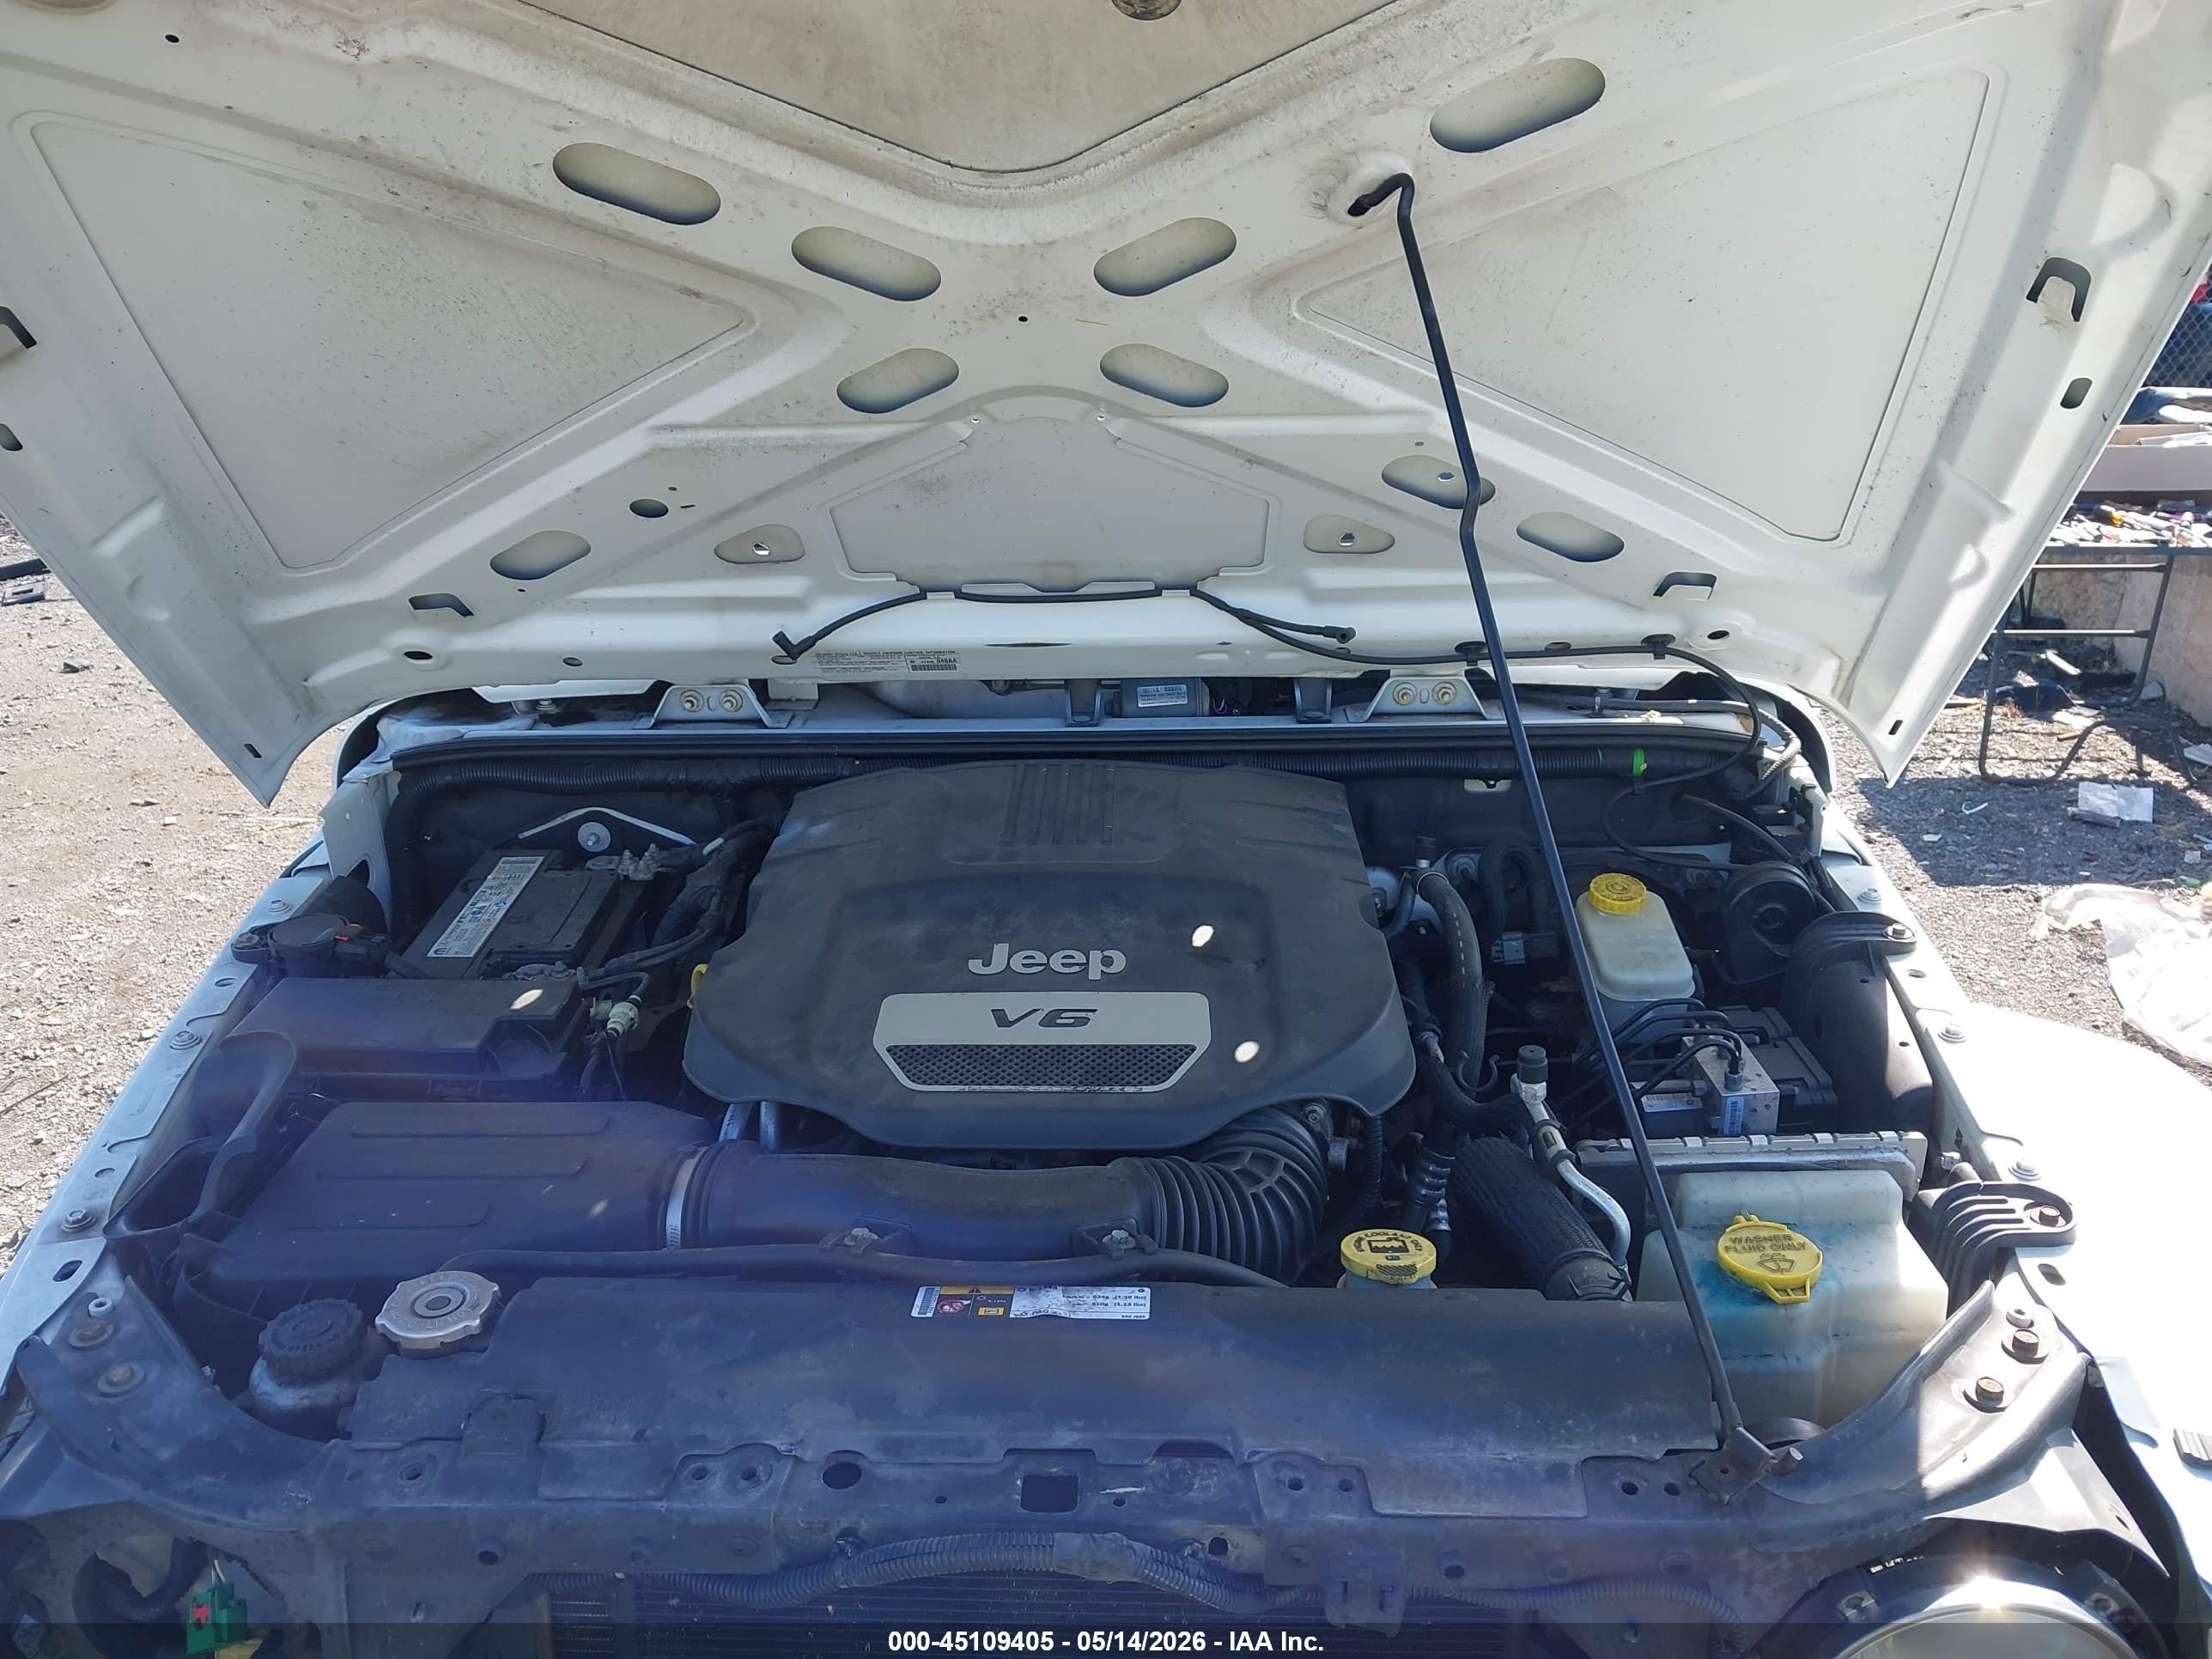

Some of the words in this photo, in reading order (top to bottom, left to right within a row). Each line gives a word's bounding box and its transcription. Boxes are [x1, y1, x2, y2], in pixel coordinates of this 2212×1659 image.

[968, 943, 1127, 981] Jeep
[990, 1008, 1098, 1028] V6
[1729, 1234, 1793, 1244] WASHER
[1724, 1245, 1765, 1254] FLUID
[1770, 1242, 1806, 1252] ONLY
